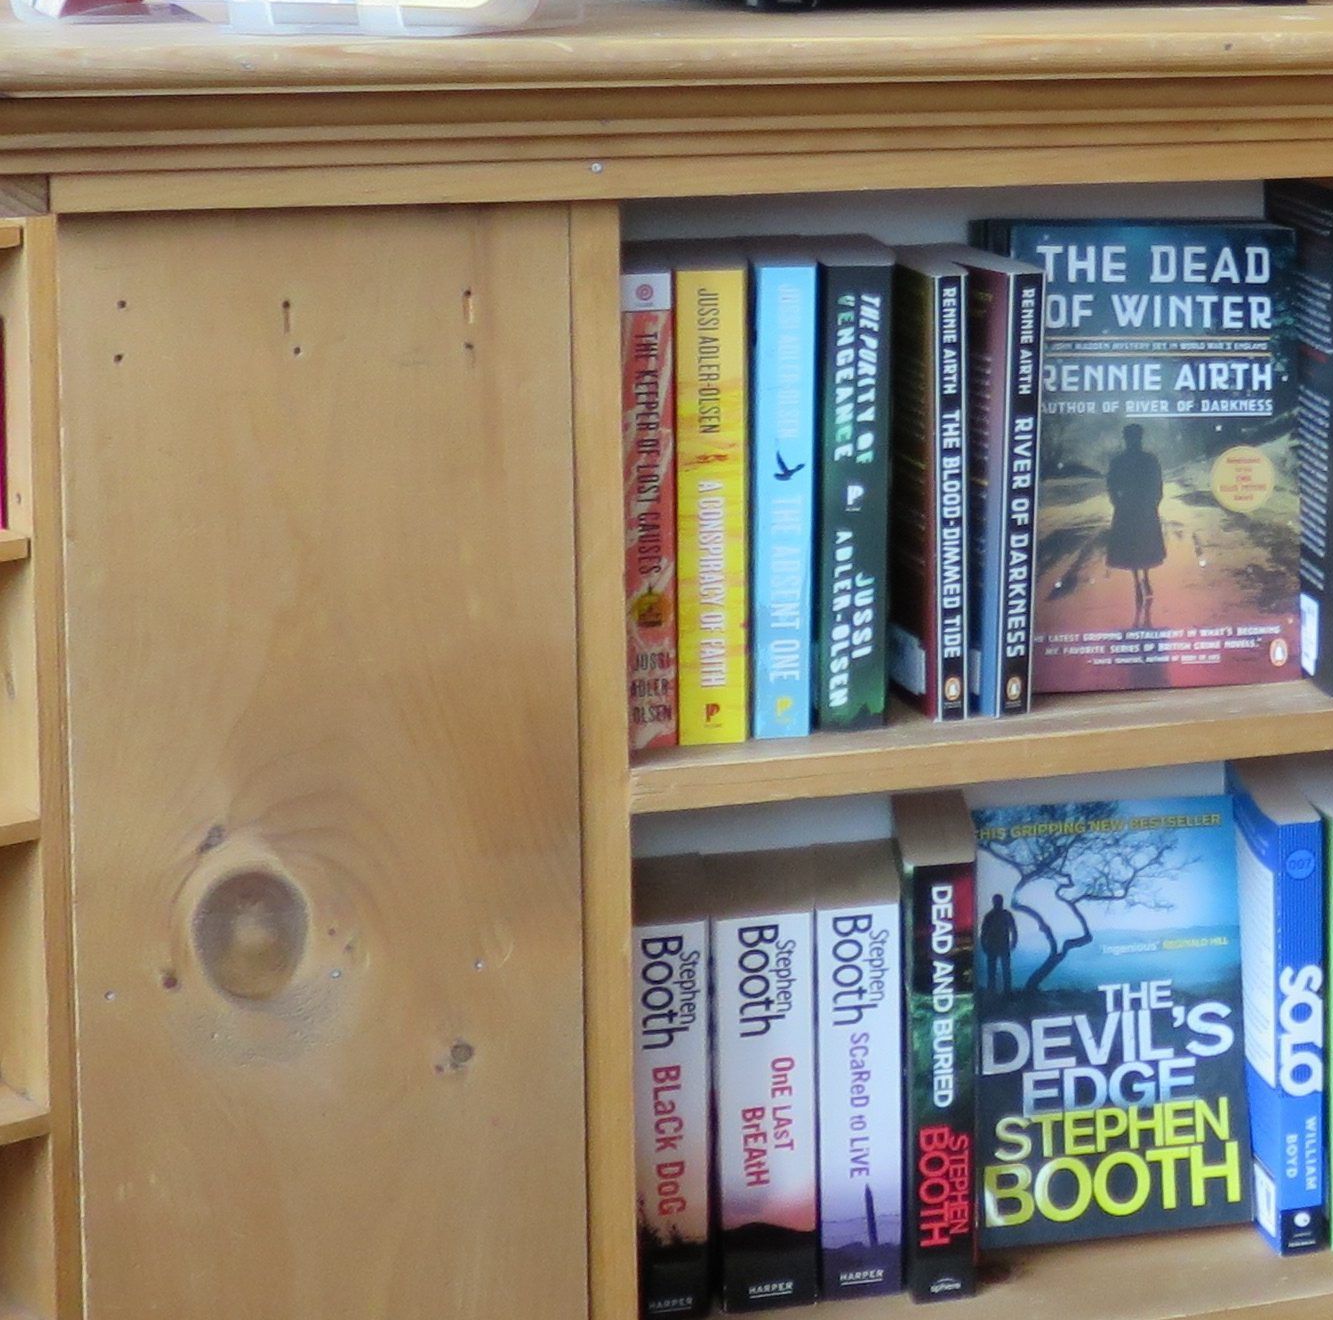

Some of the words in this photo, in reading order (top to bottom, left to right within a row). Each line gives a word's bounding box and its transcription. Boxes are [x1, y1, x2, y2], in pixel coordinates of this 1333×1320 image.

[1037, 245, 1126, 283] THE
[1150, 245, 1271, 284] DEAD
[942, 287, 957, 340] RENNIE
[1047, 294, 1093, 328] OF
[1115, 294, 1271, 329] WINTER
[942, 346, 956, 394] AIRTH
[1175, 362, 1272, 391] AIRTH
[943, 410, 961, 444] THE
[1014, 417, 1033, 490] RIVER
[943, 450, 962, 607] BLOOD-DIMMED
[1013, 498, 1029, 527] OF
[1006, 532, 1031, 657] DARKNESS
[941, 612, 961, 658] TIDE
[931, 885, 953, 954] DEAD
[869, 929, 889, 1004] Stephen
[932, 960, 953, 1013] AND
[1098, 980, 1174, 1014] THE
[932, 1019, 952, 1108] BURIED
[981, 1003, 1235, 1076] DEVIL'S
[1023, 1057, 1196, 1118] EDGE
[994, 1097, 1229, 1161] STEPHEN
[1286, 1134, 1297, 1179] BOYD
[1305, 1116, 1317, 1192] WILLIAM
[984, 1141, 1241, 1228] BOOTH
